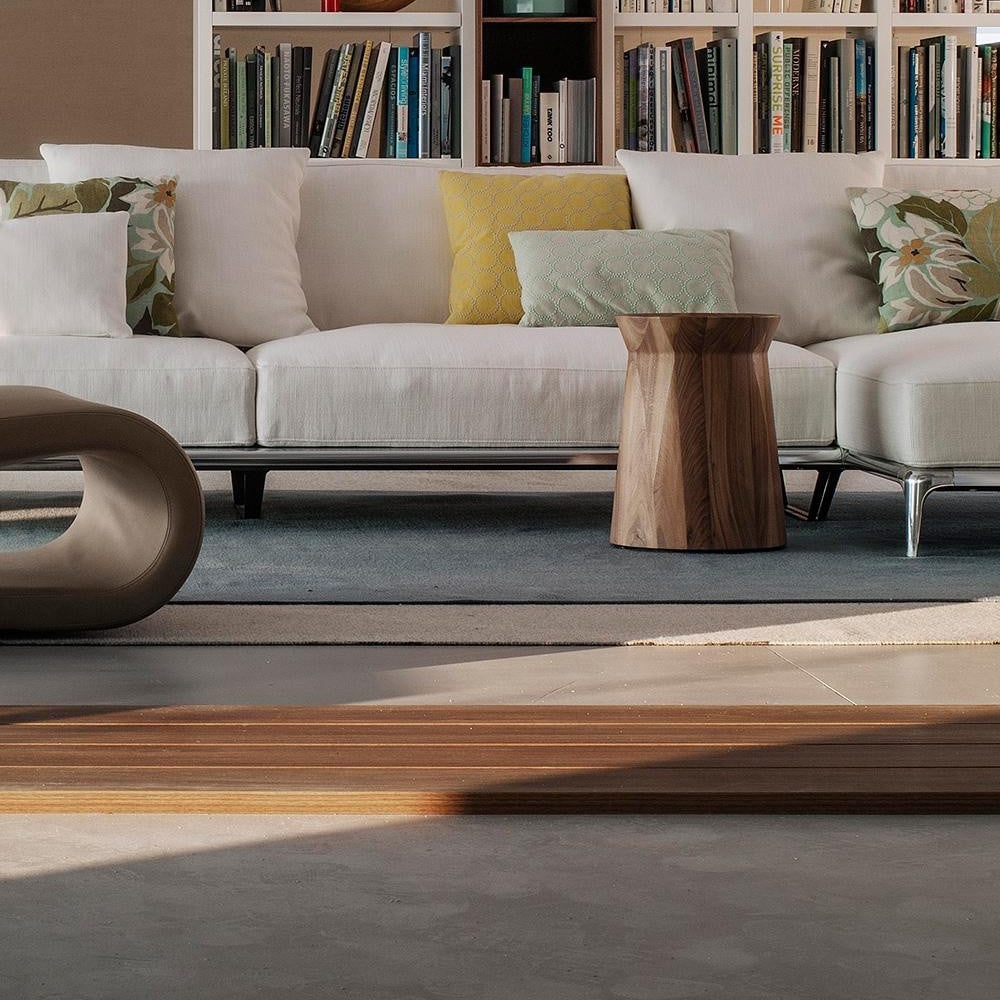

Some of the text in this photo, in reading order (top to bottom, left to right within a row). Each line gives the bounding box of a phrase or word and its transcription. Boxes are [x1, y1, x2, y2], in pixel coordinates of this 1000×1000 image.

[707, 48, 718, 108] minimal
[773, 47, 782, 135] SURPRISE ME
[791, 49, 800, 96] MODERNE
